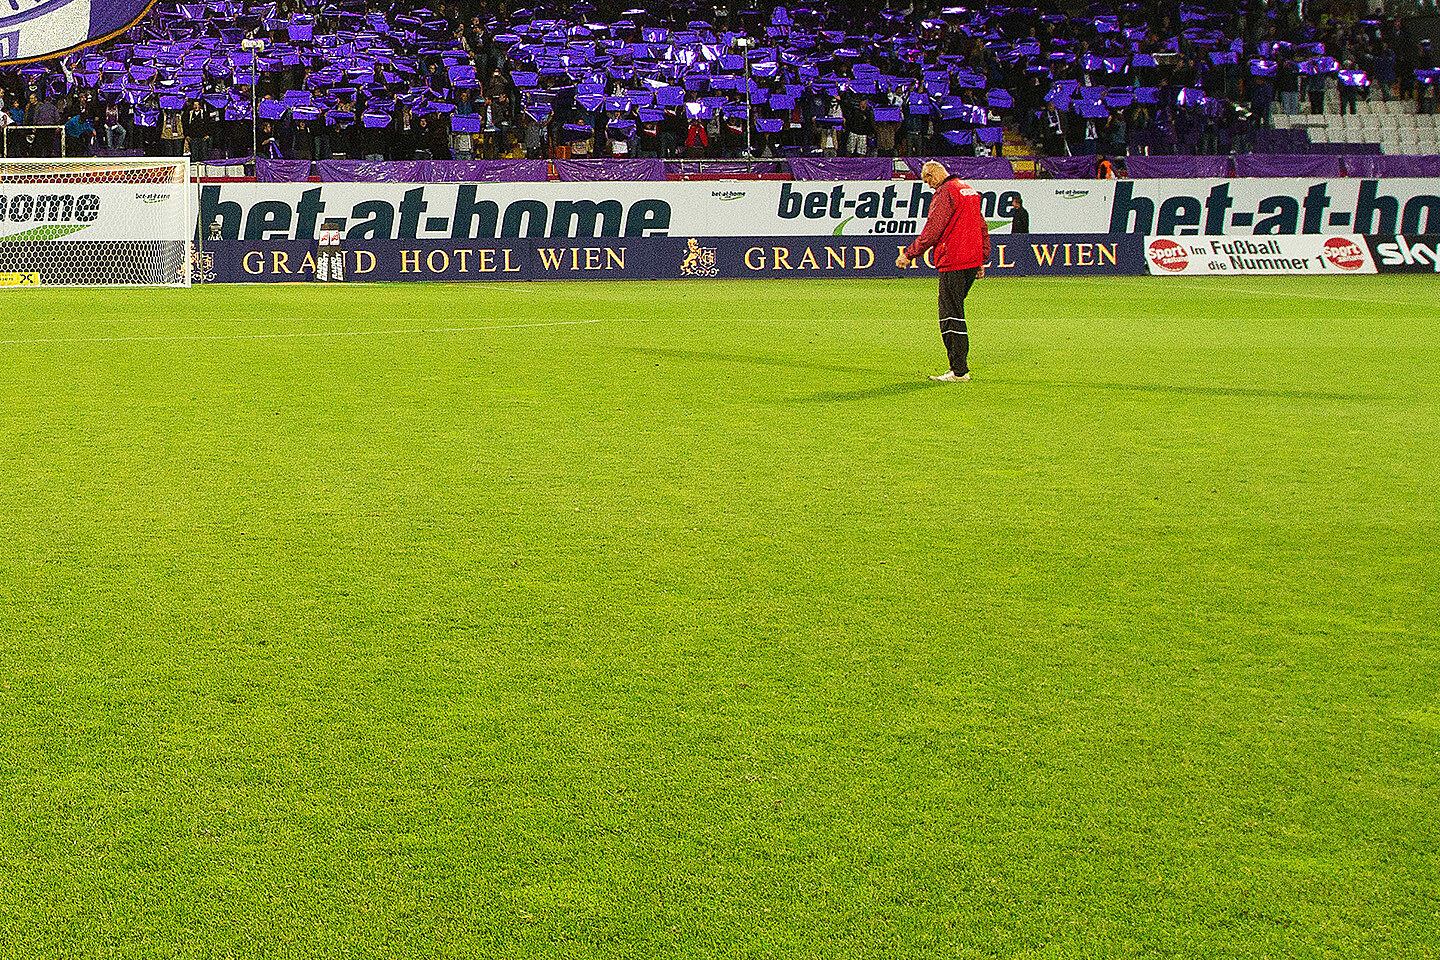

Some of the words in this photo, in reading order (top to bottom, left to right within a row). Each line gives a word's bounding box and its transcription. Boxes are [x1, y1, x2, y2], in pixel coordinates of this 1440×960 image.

[200, 185, 672, 240] bet-at-home
[868, 220, 917, 235] .com
[744, 246, 875, 271] GRAND
[1031, 243, 1117, 267] WIEN
[1189, 246, 1207, 255] Im
[1210, 240, 1282, 256] Fußball
[400, 249, 521, 273] HOTEL
[538, 247, 626, 271] WIEN
[1208, 260, 1227, 271] die
[1229, 255, 1310, 270] Nummer
[1315, 255, 1327, 269] 1
